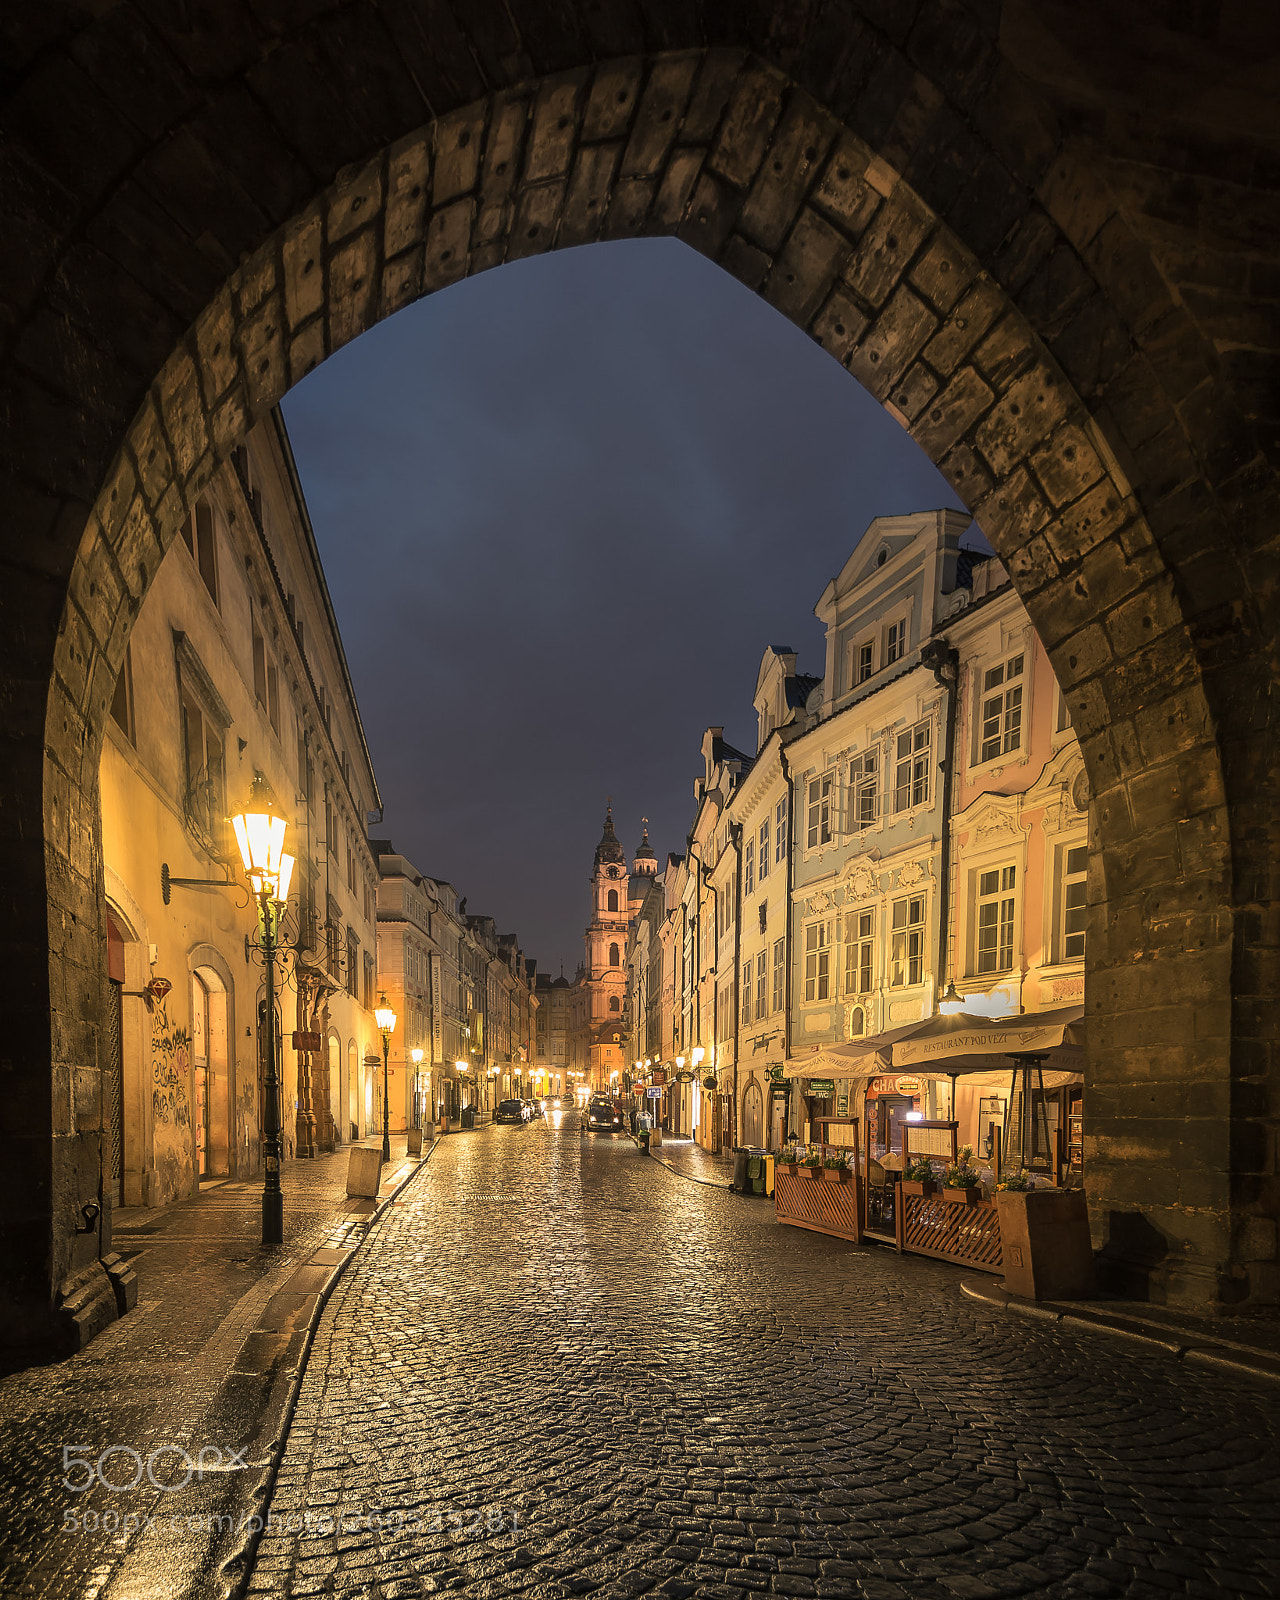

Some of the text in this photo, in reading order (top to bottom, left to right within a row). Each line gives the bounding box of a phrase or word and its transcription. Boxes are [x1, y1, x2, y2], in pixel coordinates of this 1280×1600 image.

[923, 1036, 970, 1053] RESTAURANT
[970, 1035, 986, 1046] POD
[872, 1079, 896, 1092] CHA
